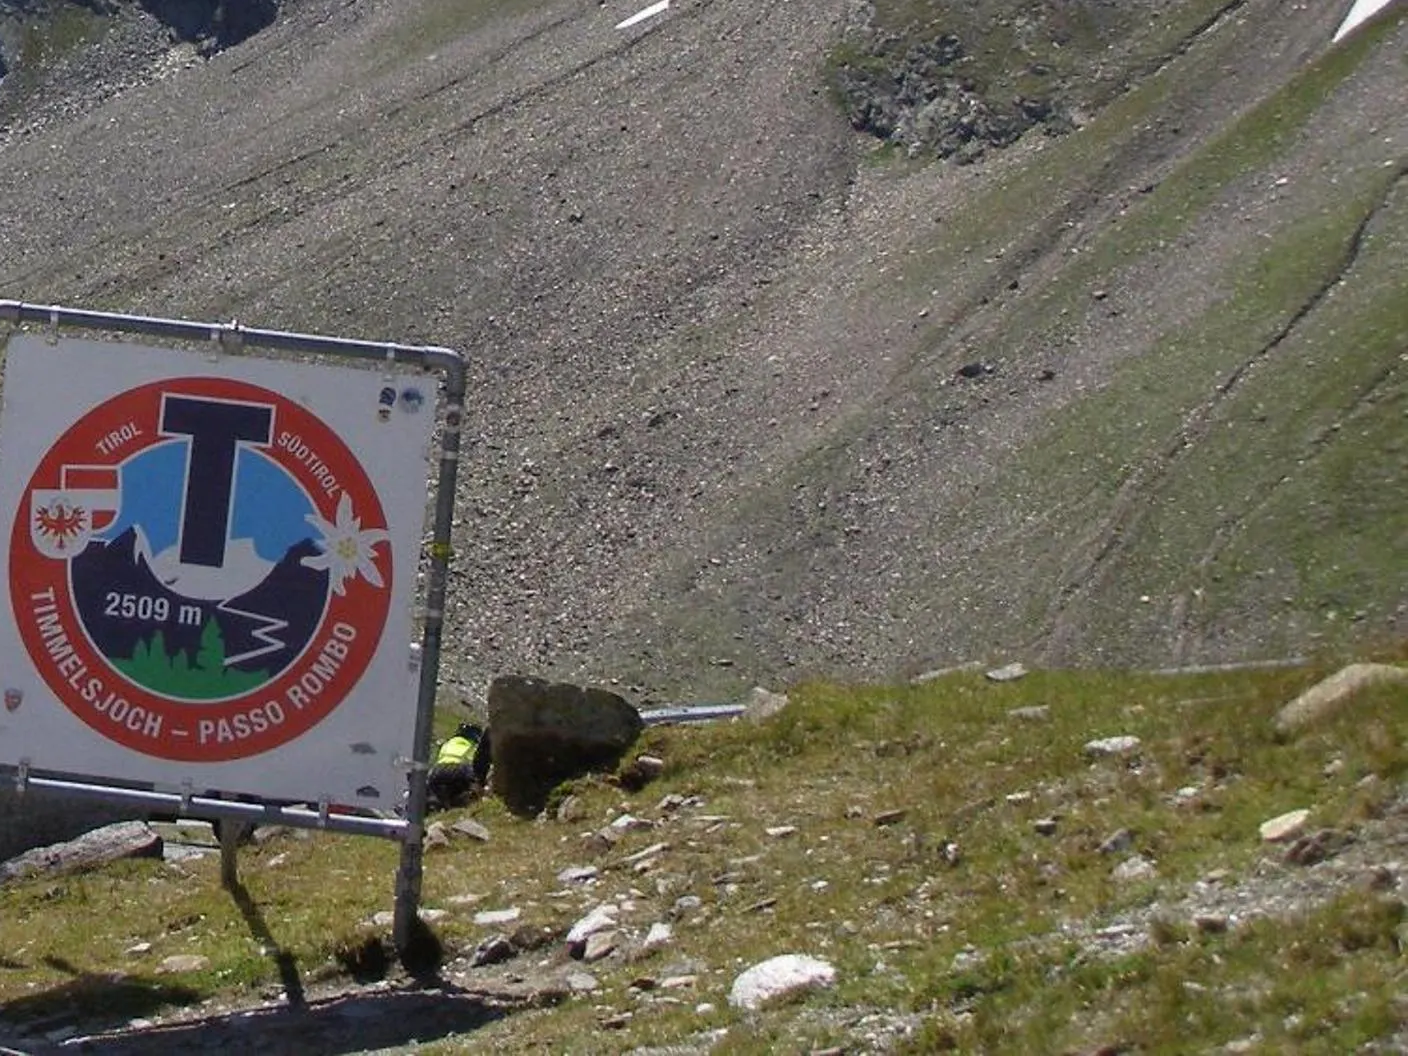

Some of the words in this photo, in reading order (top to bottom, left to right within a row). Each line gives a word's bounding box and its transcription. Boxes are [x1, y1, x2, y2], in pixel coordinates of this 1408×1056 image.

[96, 421, 144, 455] TIROL
[278, 430, 342, 498] SÜDTIROL
[104, 592, 169, 621] 2509
[178, 604, 202, 626] m
[31, 586, 164, 738] TIMMELSJOCH
[199, 703, 285, 744] PASSO
[287, 621, 357, 710] ROMBO
